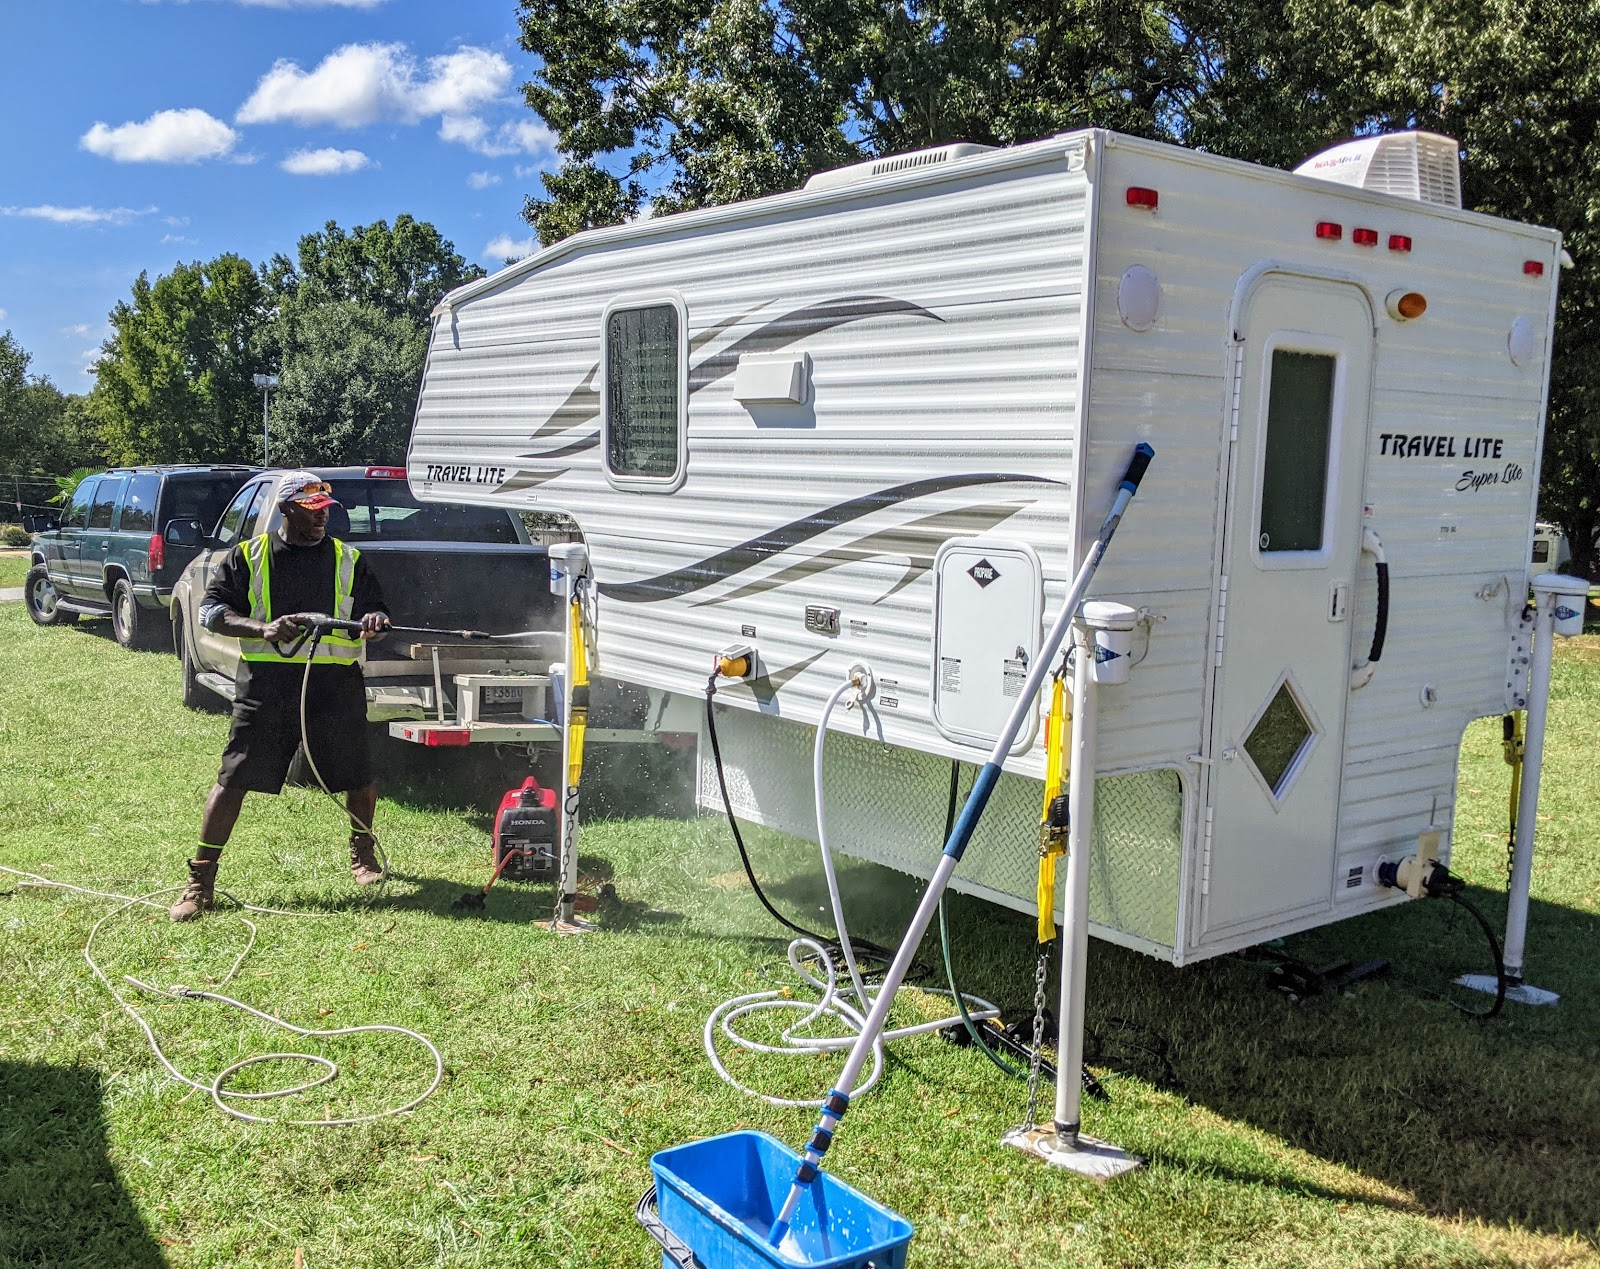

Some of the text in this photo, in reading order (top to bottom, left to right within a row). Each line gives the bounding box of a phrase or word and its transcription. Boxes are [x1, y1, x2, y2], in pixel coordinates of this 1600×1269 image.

[1379, 433, 1503, 459] TRAVEL LITE
[427, 464, 506, 484] TRAVEL LITE
[1455, 463, 1523, 492] Super Lite
[974, 566, 993, 580] PROPANE
